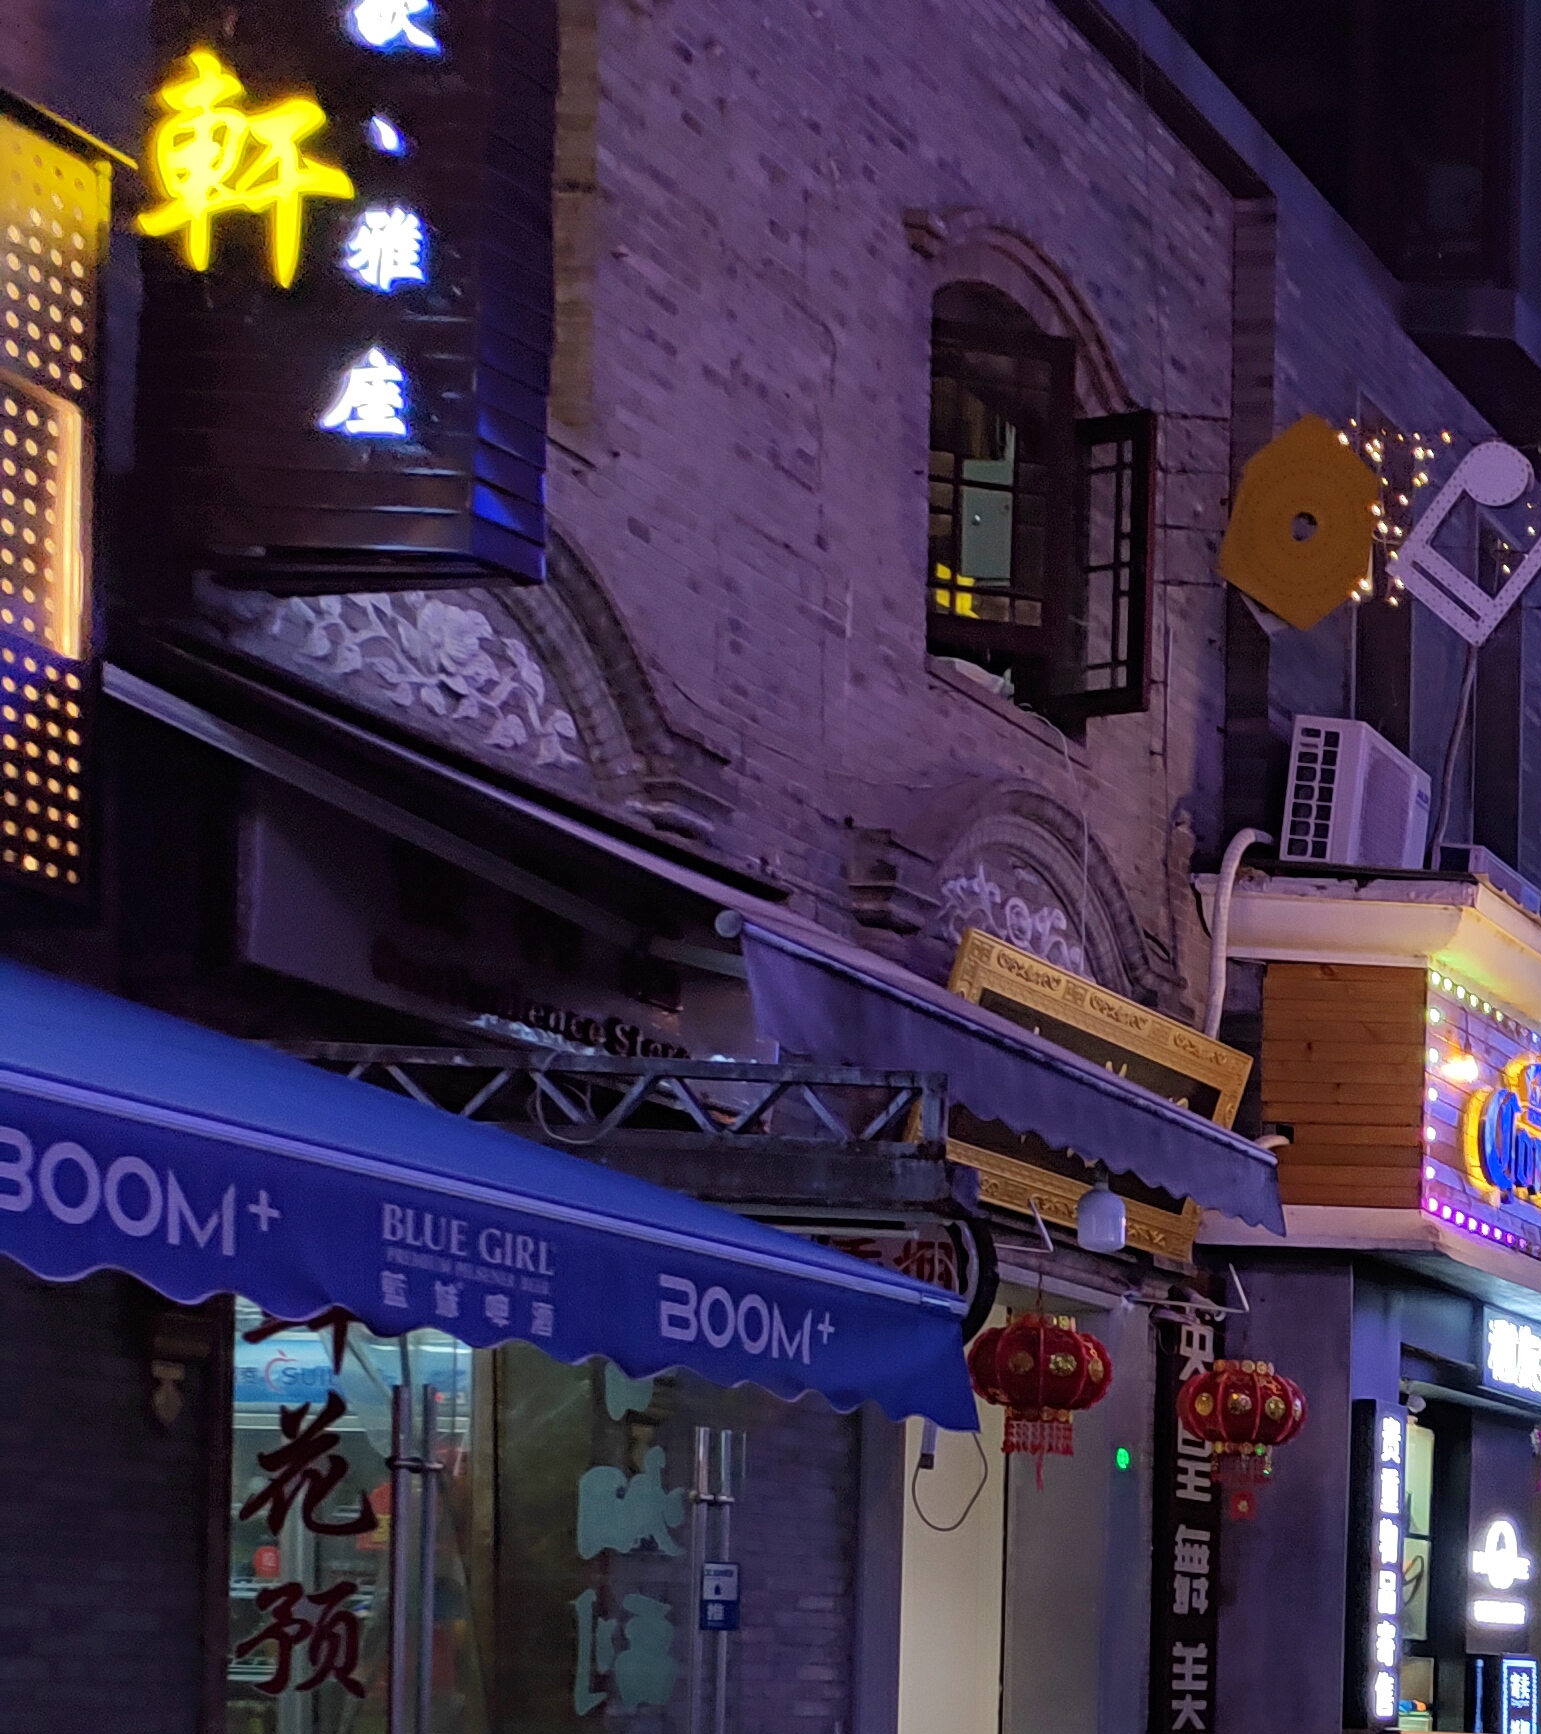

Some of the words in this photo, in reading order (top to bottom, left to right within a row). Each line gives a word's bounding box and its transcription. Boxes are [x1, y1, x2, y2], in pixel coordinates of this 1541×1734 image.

[137, 49, 355, 289] 軒
[382, 1202, 468, 1257] BLUE
[479, 1227, 555, 1276] GIRL
